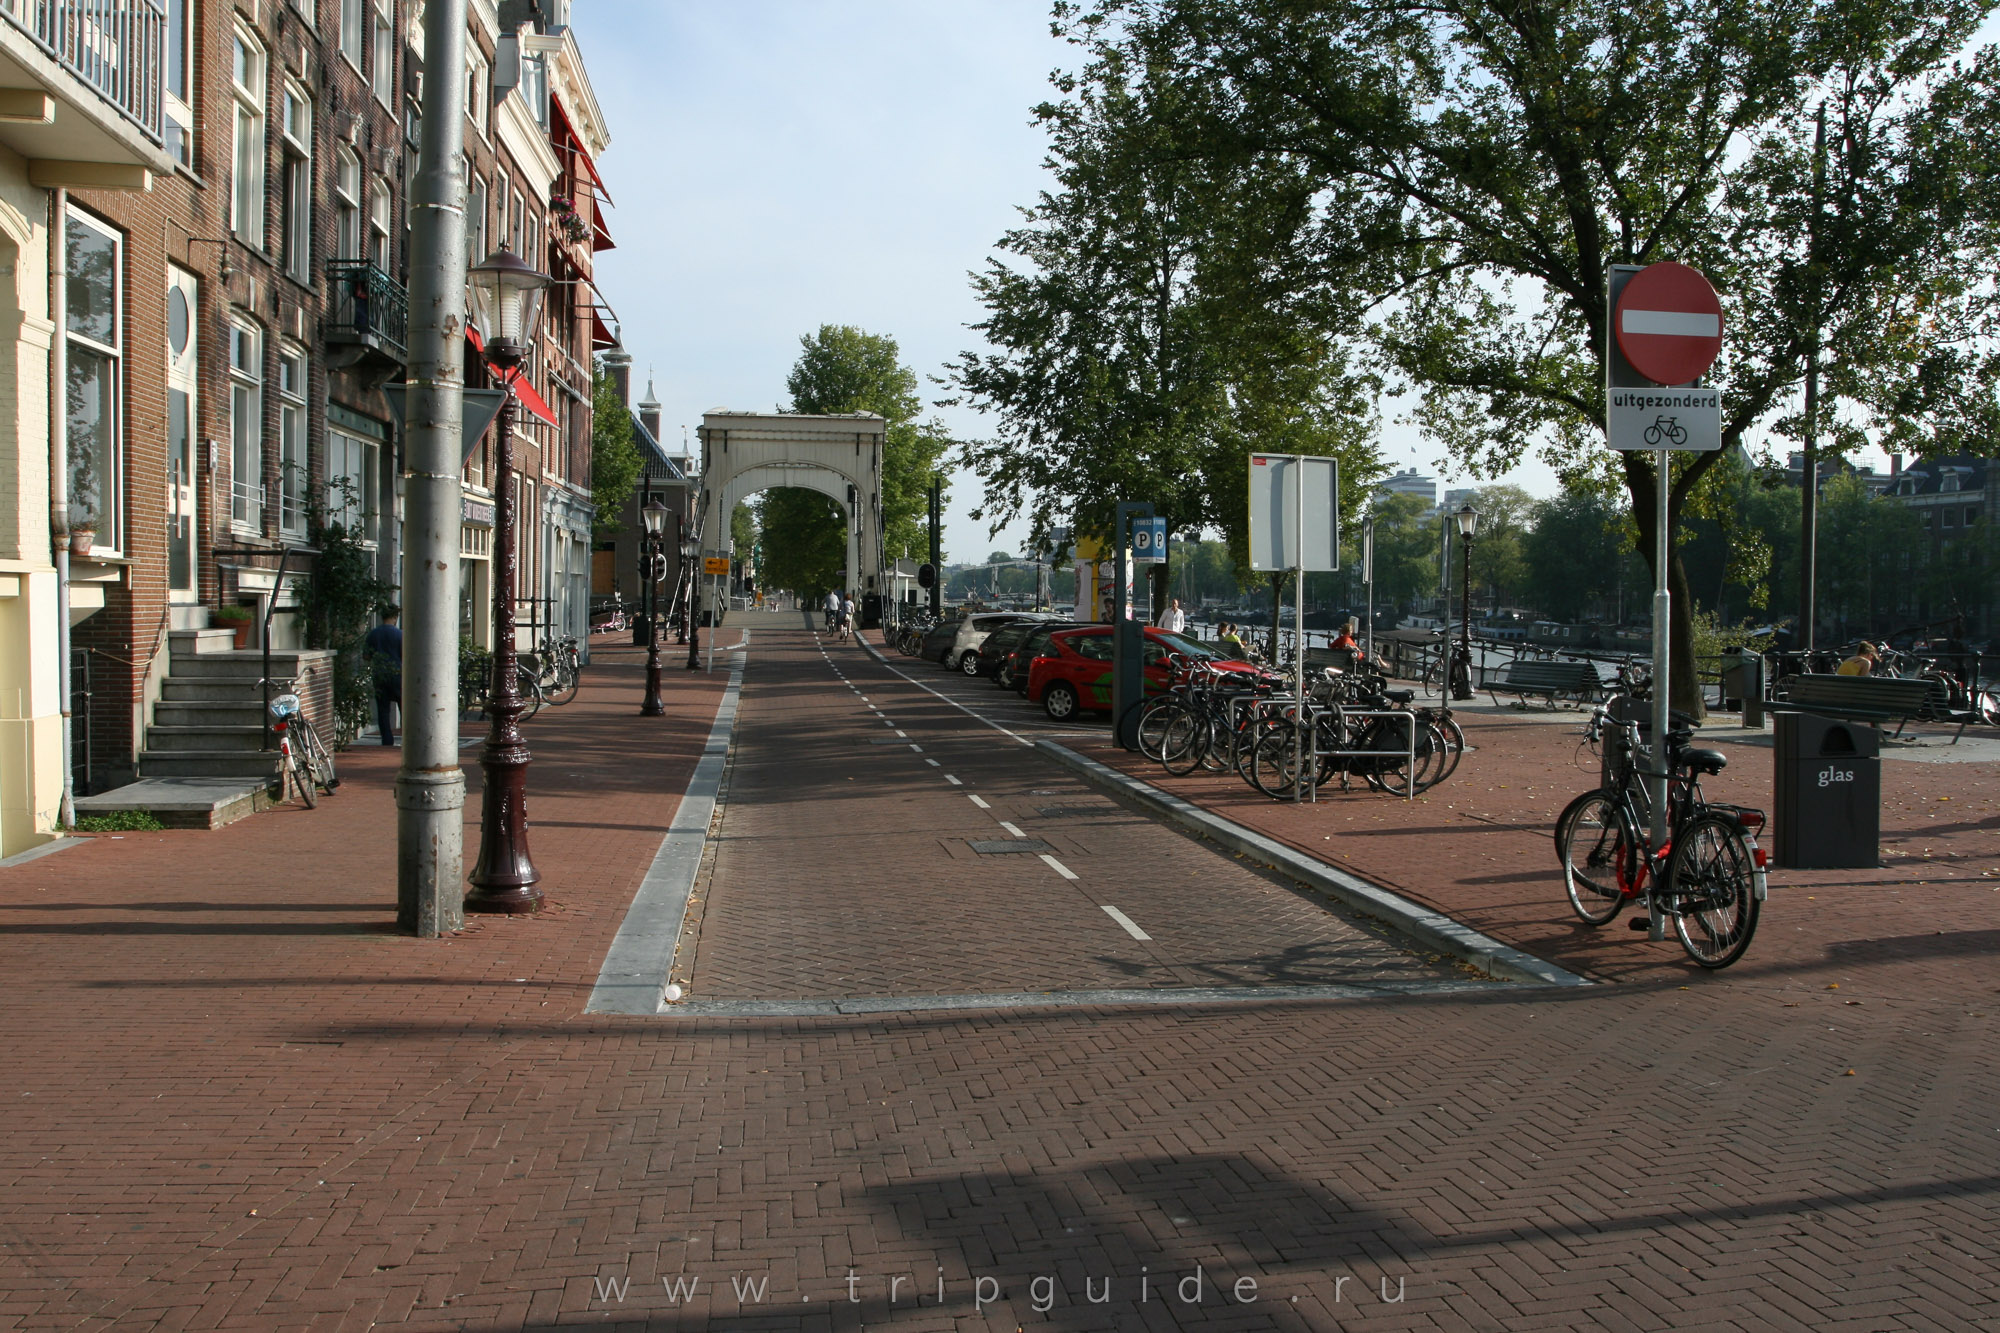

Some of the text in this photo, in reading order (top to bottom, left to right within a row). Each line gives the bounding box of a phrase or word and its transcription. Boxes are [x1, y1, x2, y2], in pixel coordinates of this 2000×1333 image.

[1614, 394, 1717, 411] uitgezonderd
[1138, 533, 1147, 547] P
[1818, 765, 1854, 787] glas
